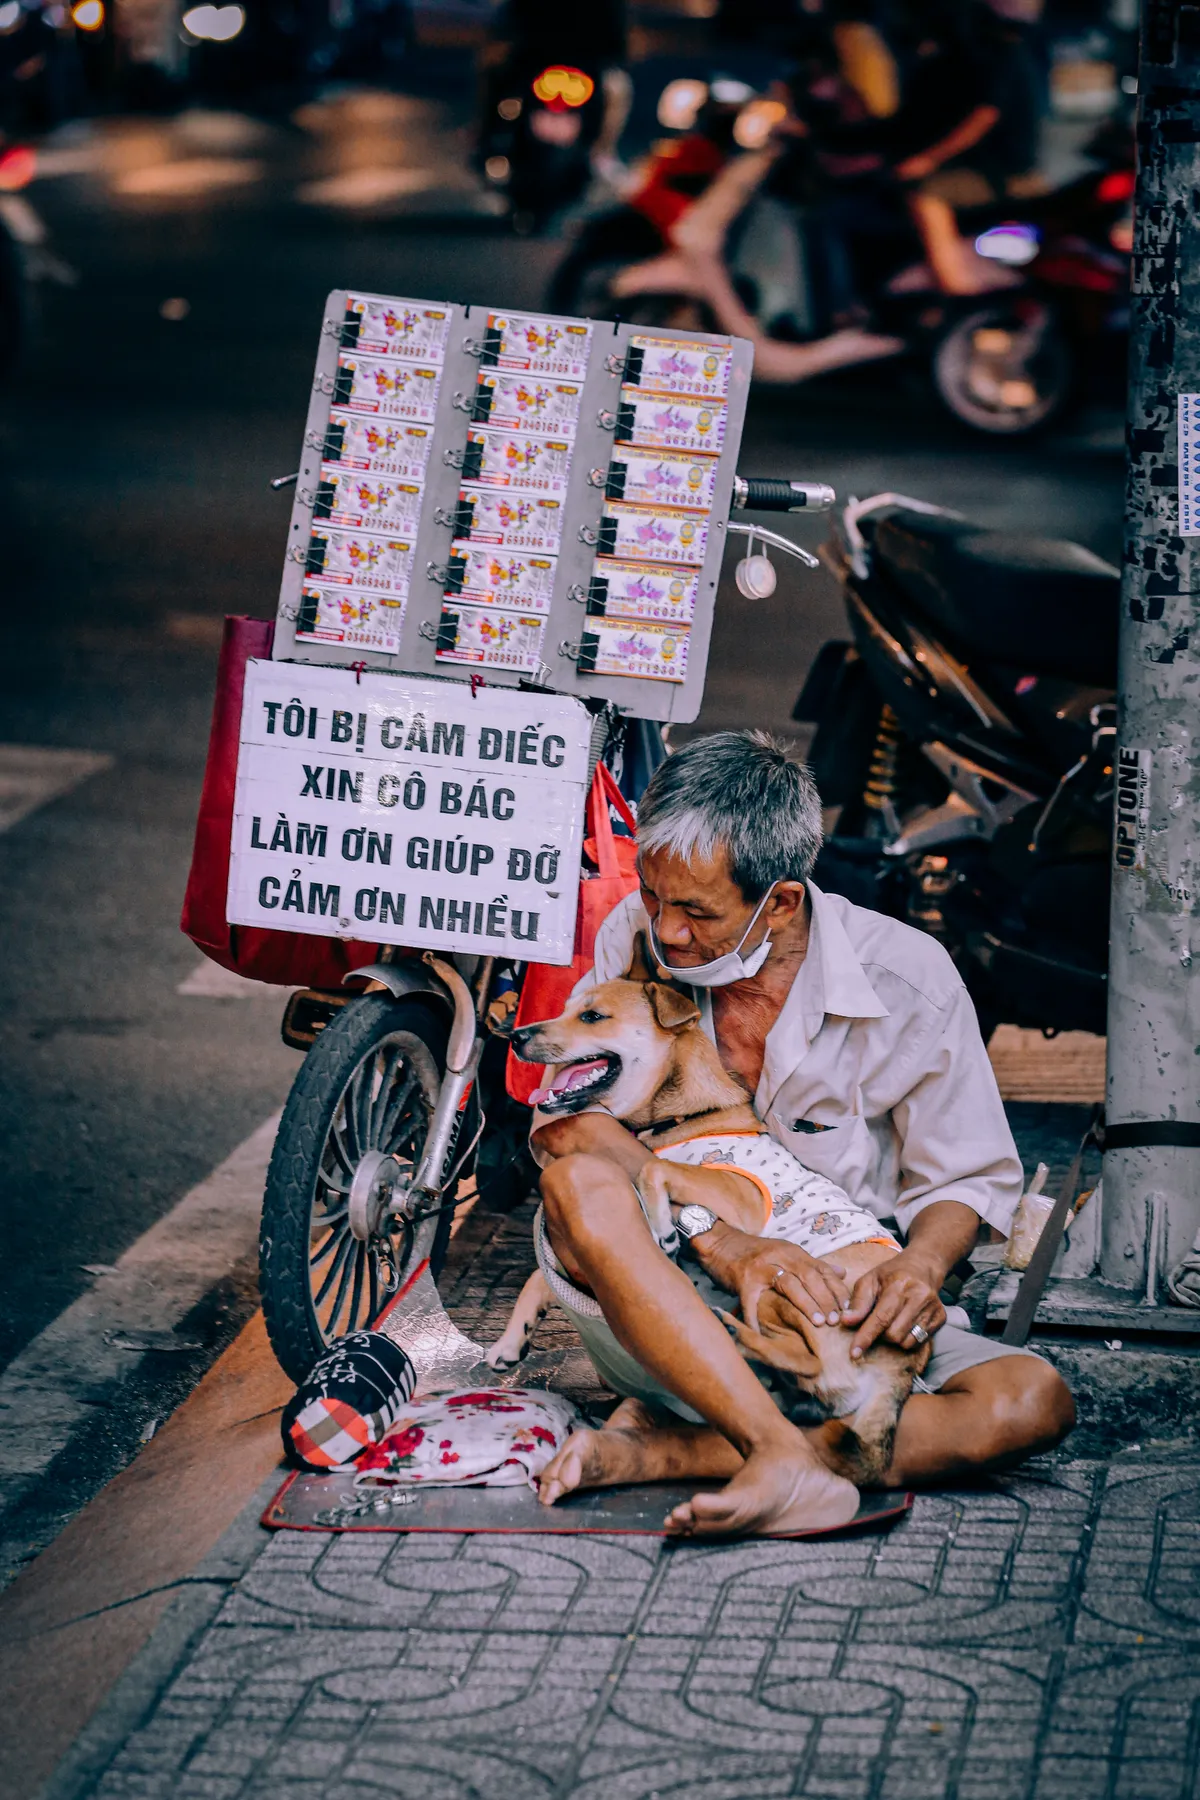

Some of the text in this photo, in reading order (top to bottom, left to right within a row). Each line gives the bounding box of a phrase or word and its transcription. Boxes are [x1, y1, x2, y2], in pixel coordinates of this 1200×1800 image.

[262, 697, 566, 768] TÔI BỊ CÂM ĐIẾC
[299, 764, 516, 821] XIN CÔ BÁC
[1116, 747, 1139, 867] OPTONE
[250, 812, 561, 885] LÀM ƠN GIÚP ĐỠ
[258, 868, 341, 918] CẢM
[354, 886, 406, 926] ƠN
